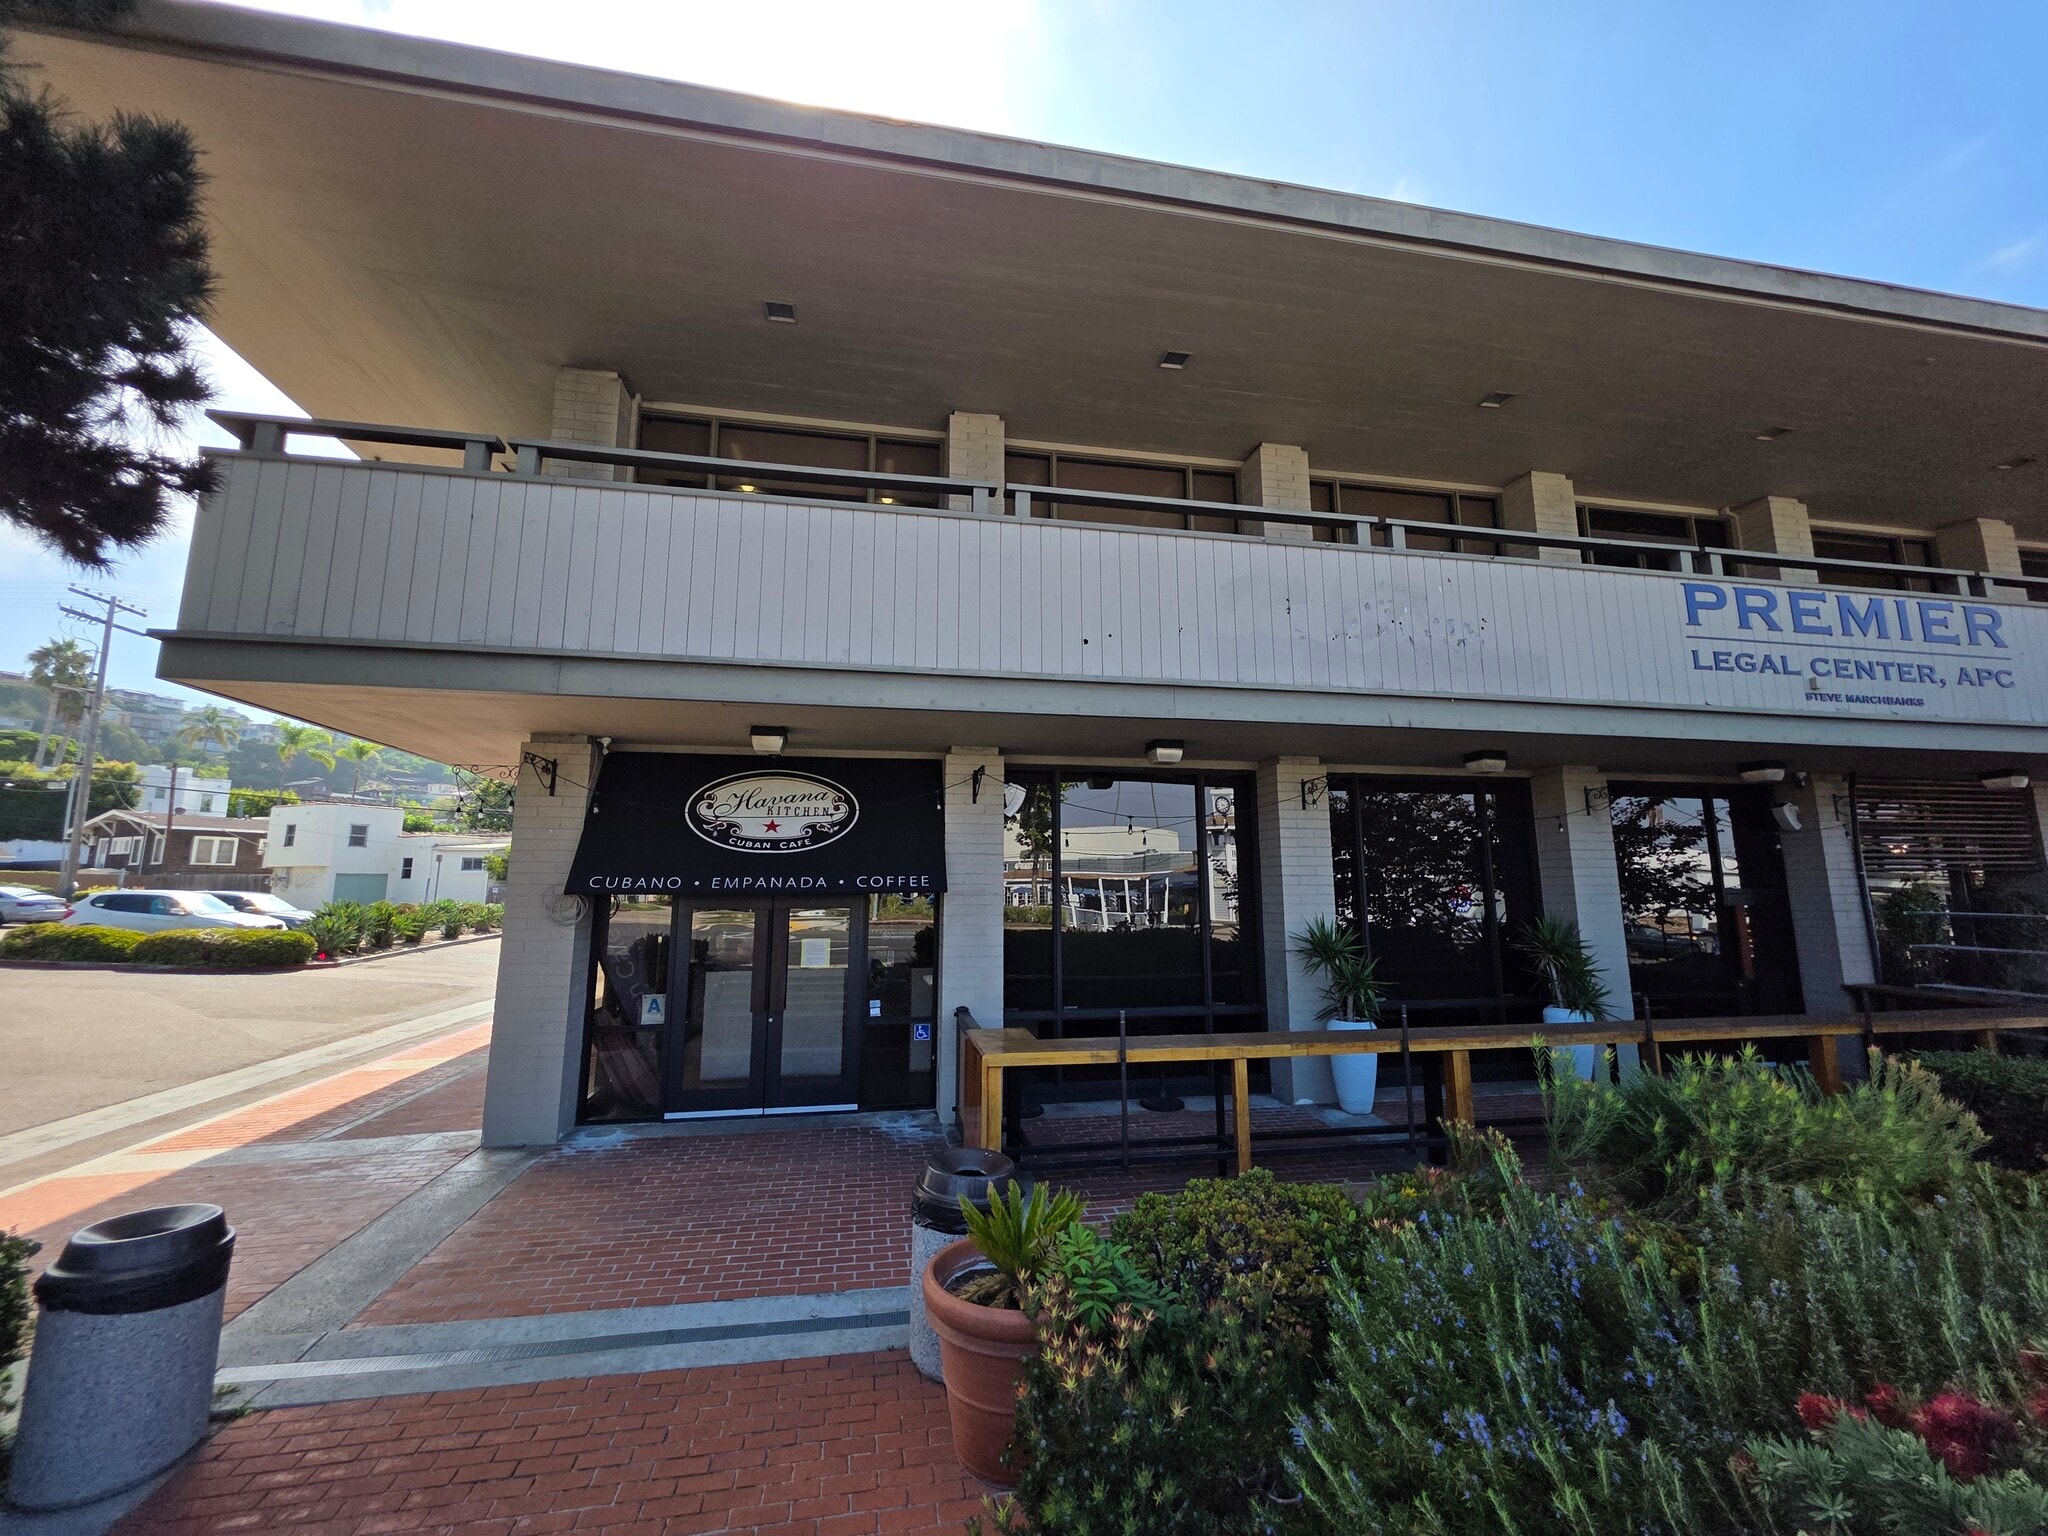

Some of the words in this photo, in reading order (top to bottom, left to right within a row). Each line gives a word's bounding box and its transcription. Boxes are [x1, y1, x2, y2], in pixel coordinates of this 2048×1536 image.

[1681, 582, 2008, 648] PREMIER
[1691, 650, 1802, 676] LEGAL
[1809, 657, 1947, 688] CENTER,
[1957, 667, 2016, 689] APC
[1805, 692, 1842, 702] STEVE
[1845, 694, 1924, 707] MARCHBANKS
[713, 786, 830, 816] Havana
[766, 805, 830, 817] KITCHEN
[728, 837, 771, 849] CUBAN
[779, 838, 813, 849] CAFE
[589, 876, 682, 889] CUBANO
[711, 876, 827, 889] EMPANADA
[856, 875, 931, 888] COFFEE
[647, 998, 661, 1013] A
